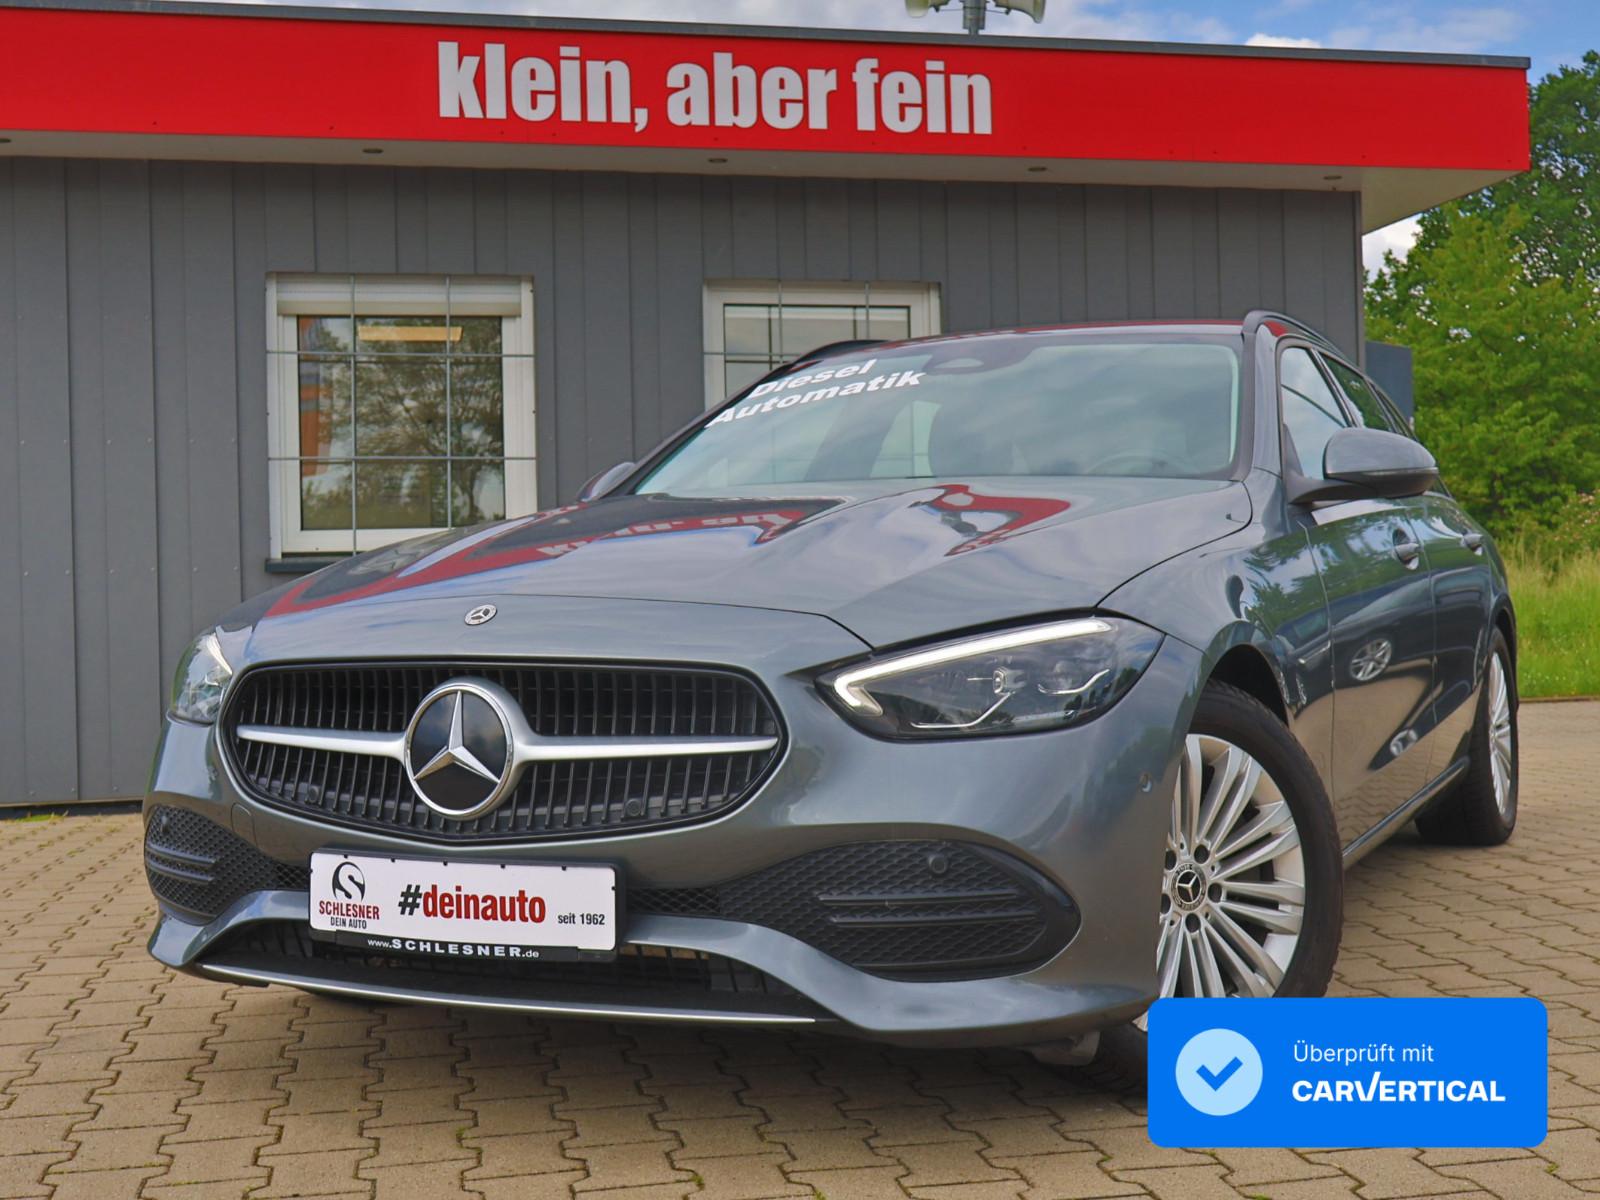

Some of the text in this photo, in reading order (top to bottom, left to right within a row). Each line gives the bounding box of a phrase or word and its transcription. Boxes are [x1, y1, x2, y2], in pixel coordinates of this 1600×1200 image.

[437, 41, 993, 135] klein, aber fein
[748, 359, 877, 399] Diesel
[704, 370, 926, 429] Automatik
[319, 900, 380, 920] SCHLESNER
[398, 884, 546, 923] #deinauto
[330, 916, 367, 930] DEIN AUTO
[557, 913, 606, 926] seit 1962
[367, 938, 540, 958] www.SCHLESNER.de
